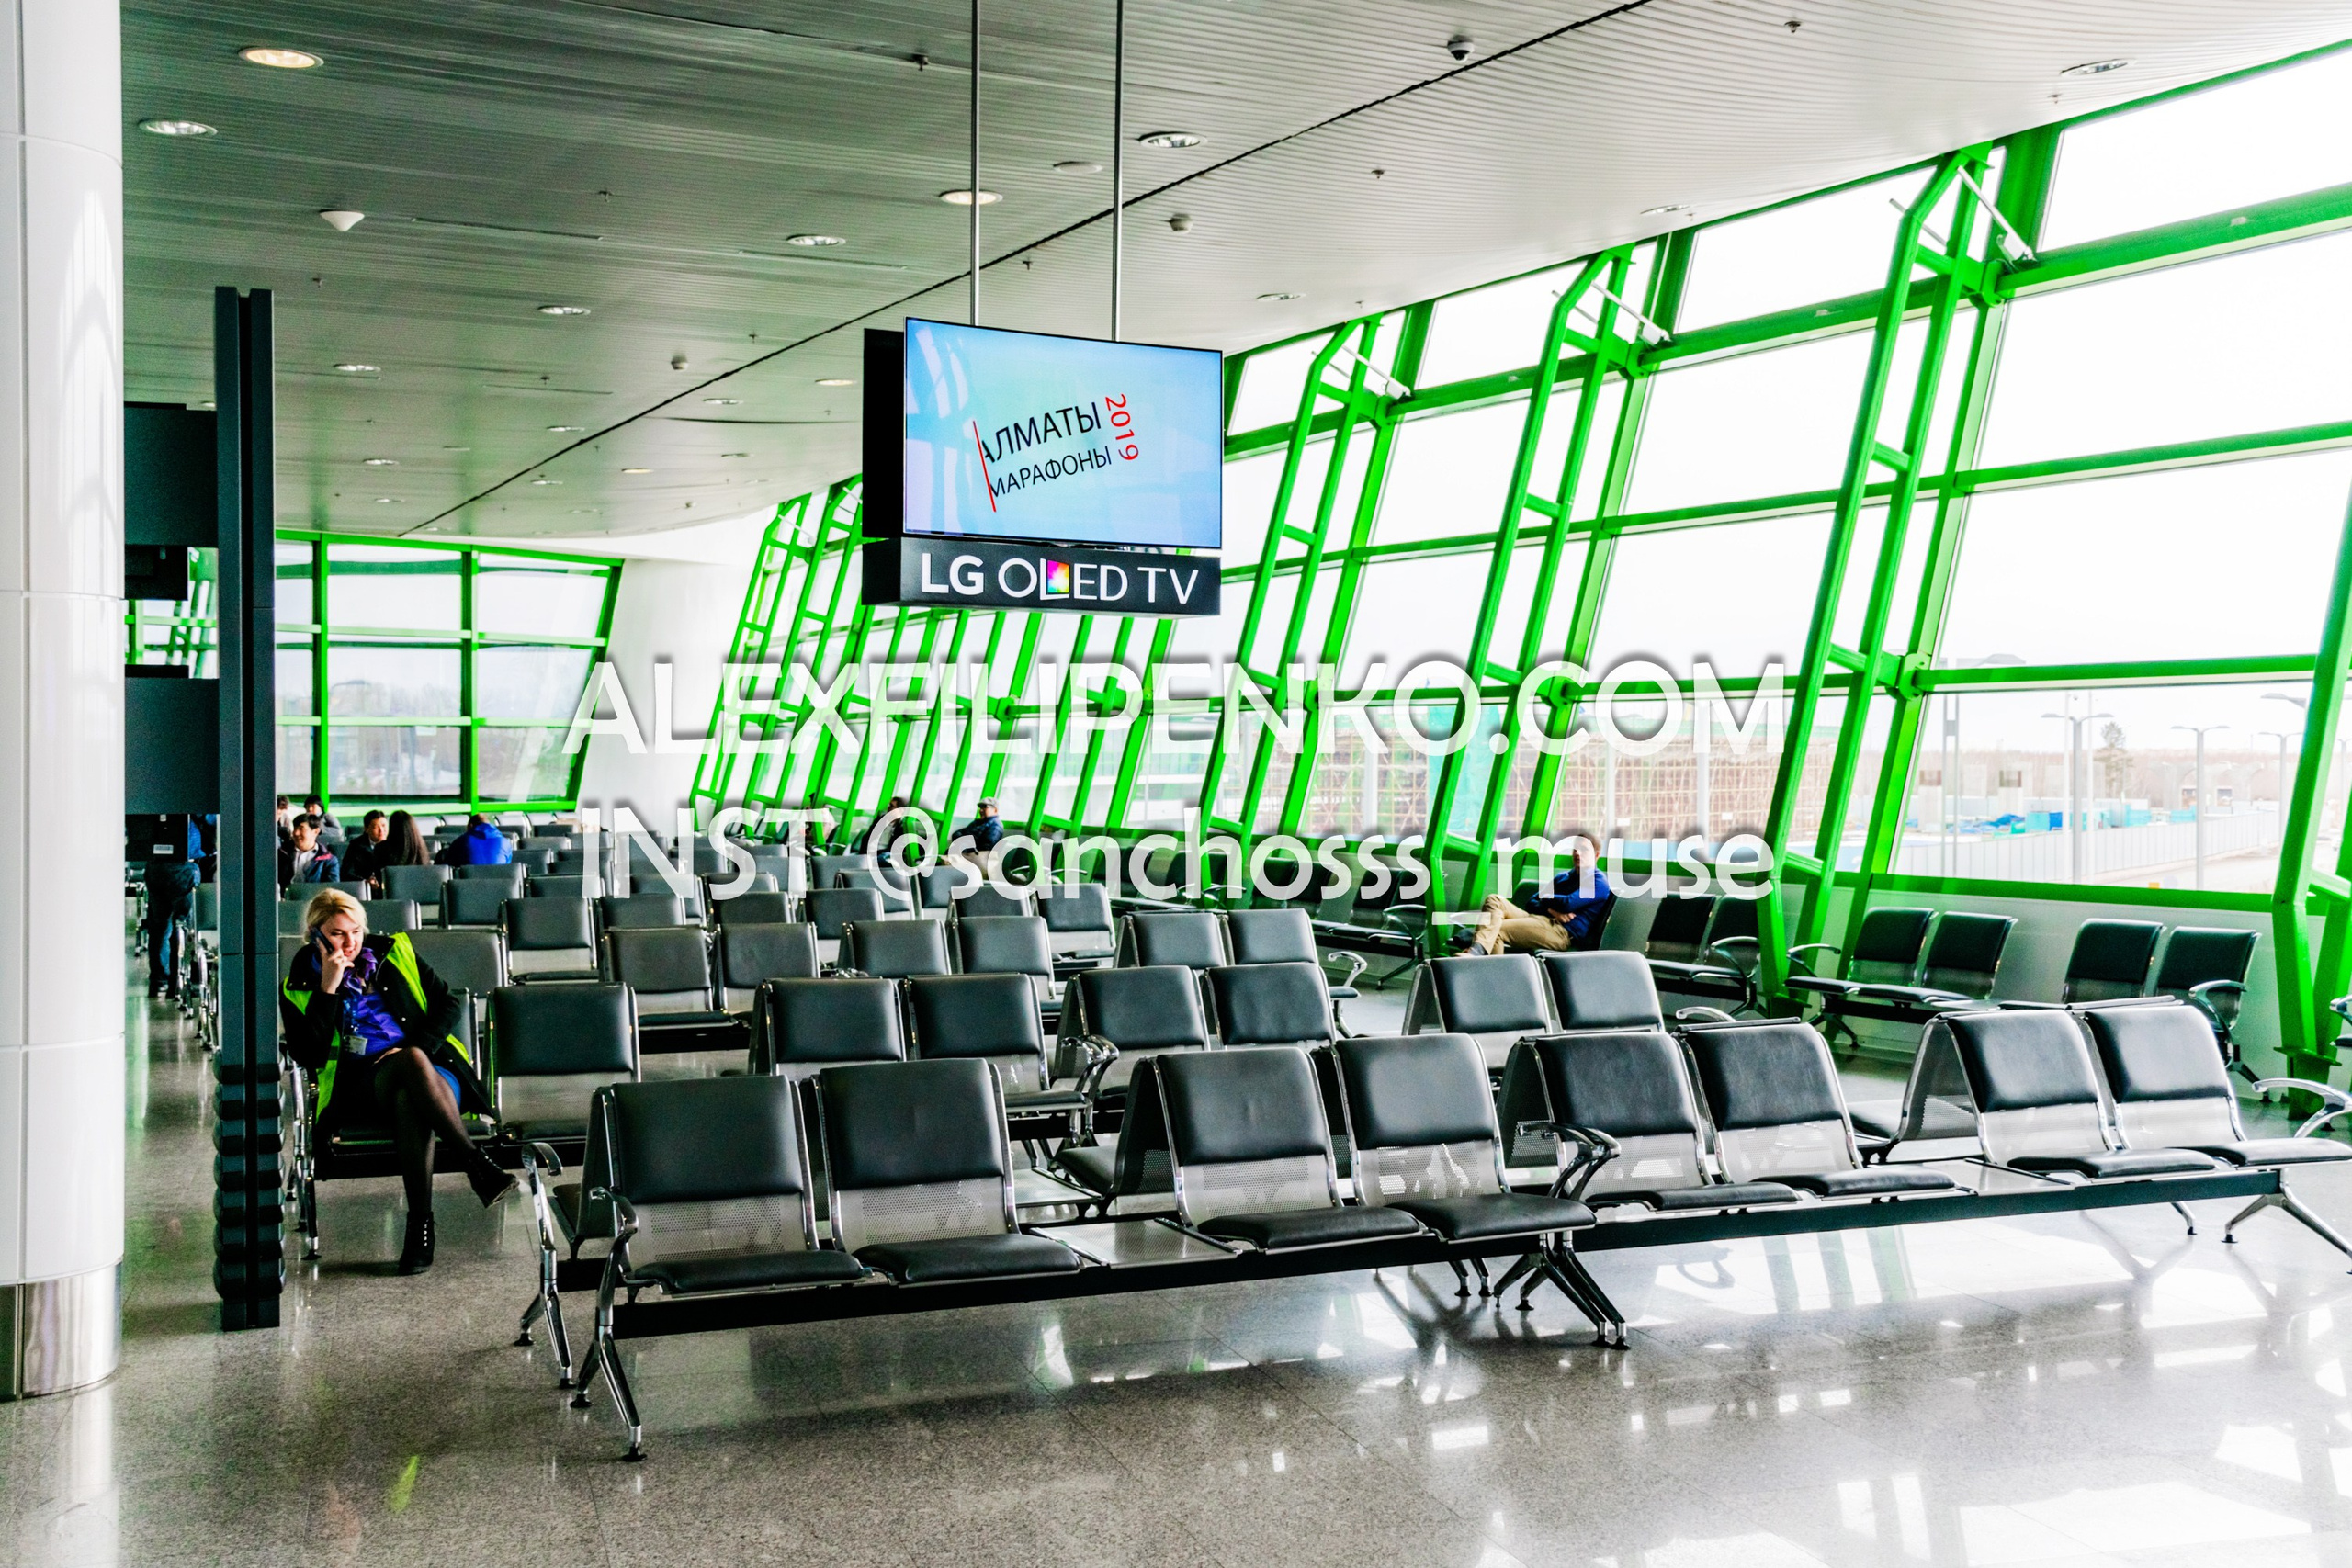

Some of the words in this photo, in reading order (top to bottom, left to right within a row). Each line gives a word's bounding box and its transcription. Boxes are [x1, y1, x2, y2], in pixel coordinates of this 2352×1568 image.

[1105, 393, 1139, 461] 2019
[922, 553, 984, 595] LG
[998, 558, 1128, 600] OLED
[1137, 567, 1199, 604] TV
